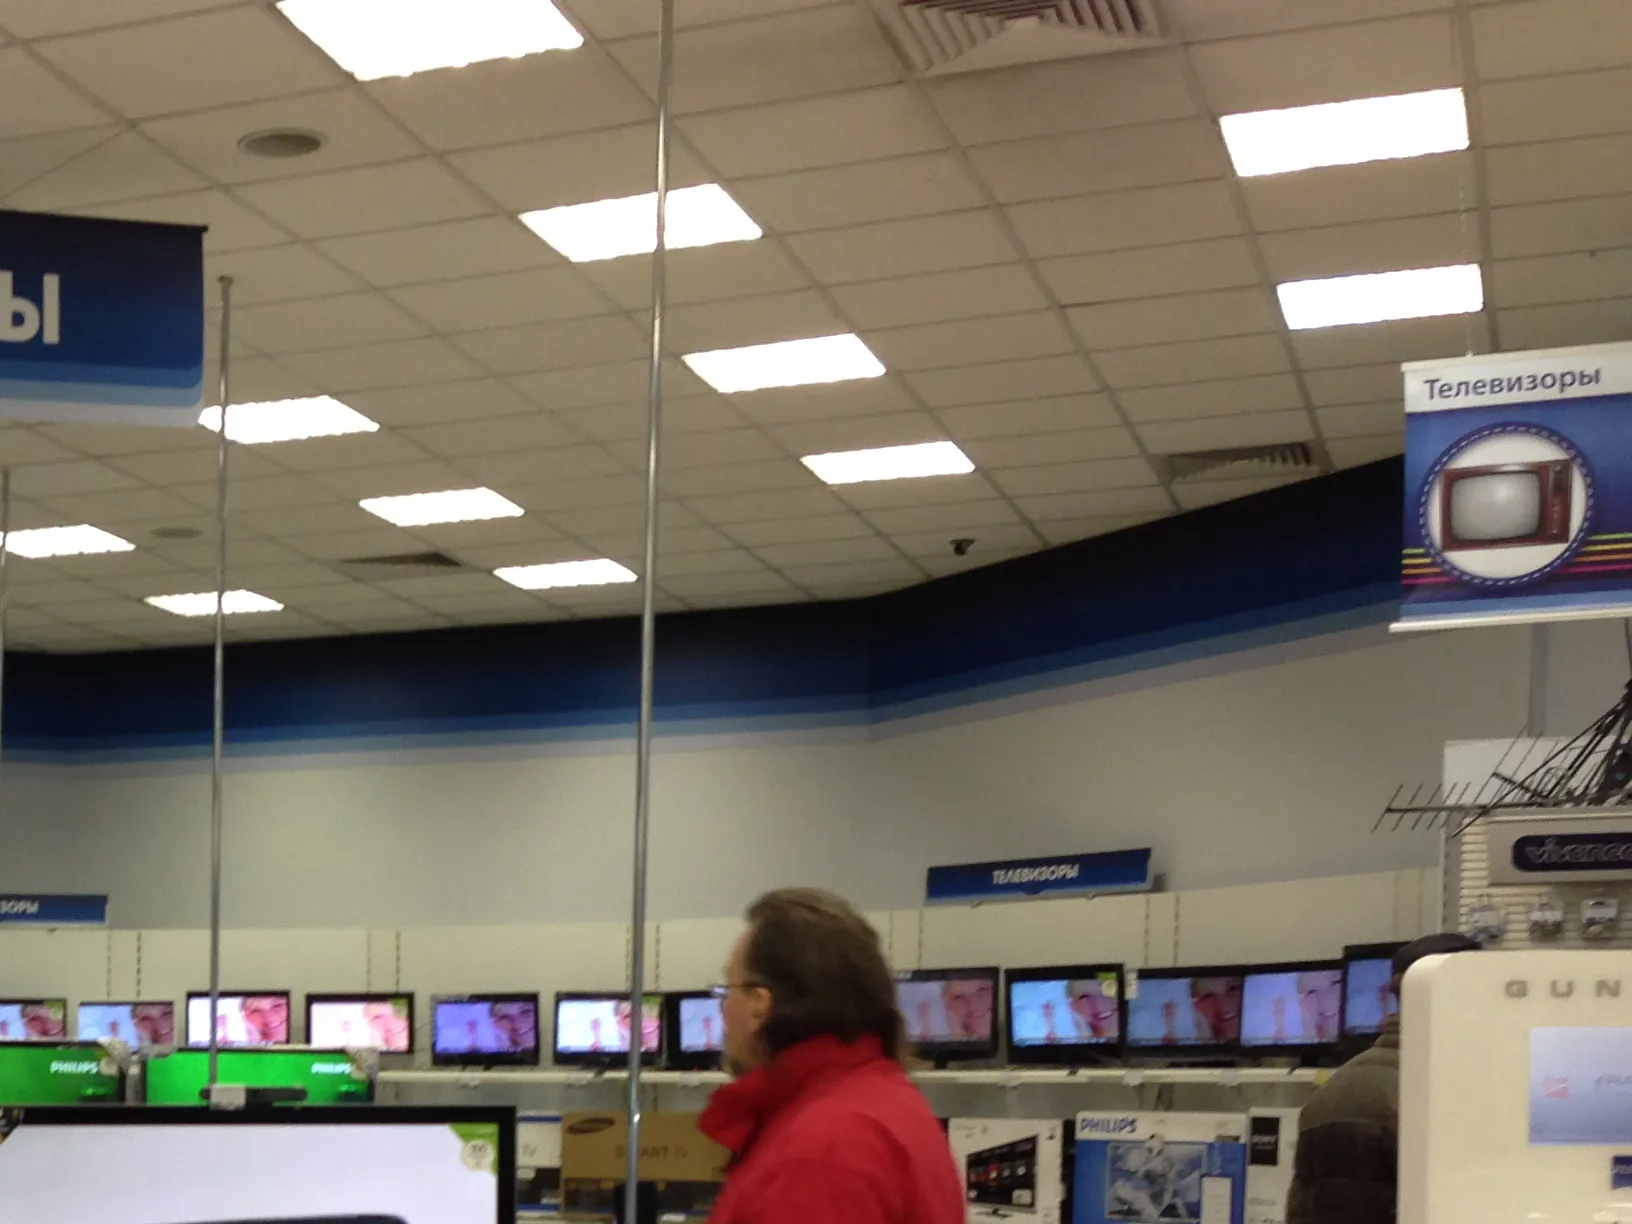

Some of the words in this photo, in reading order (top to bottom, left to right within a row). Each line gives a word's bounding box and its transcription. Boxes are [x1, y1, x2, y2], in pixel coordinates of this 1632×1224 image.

[1423, 367, 1602, 401] Телевизоры
[992, 863, 1080, 885] ТЕЛЕВИЗОРЫ
[50, 1060, 98, 1074] PHILIPS
[1079, 1117, 1137, 1134] PHILIPS
[615, 1145, 669, 1159] SART
